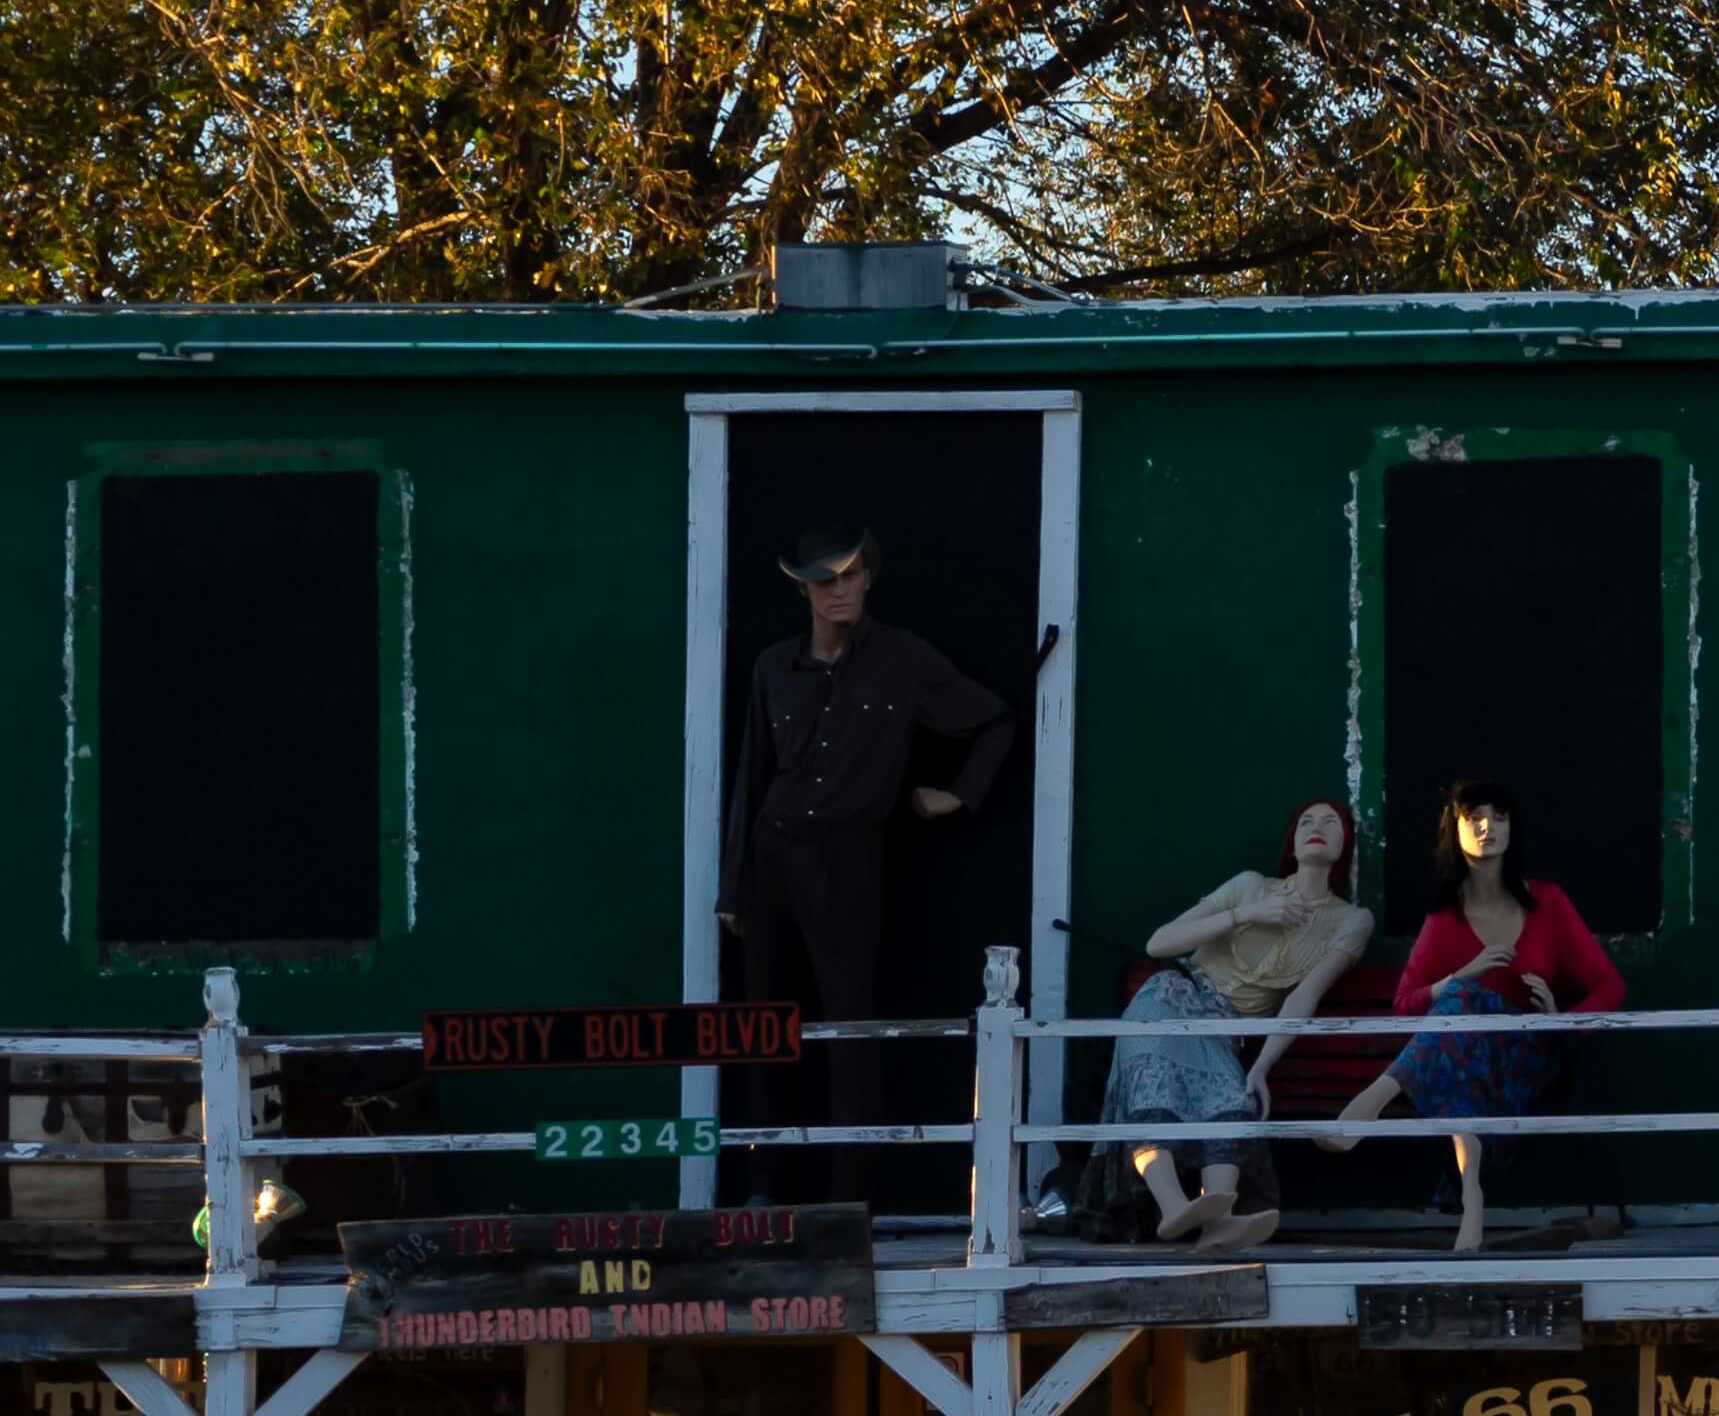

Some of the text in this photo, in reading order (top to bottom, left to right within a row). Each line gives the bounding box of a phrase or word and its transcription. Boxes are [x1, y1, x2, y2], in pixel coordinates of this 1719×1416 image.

[442, 1007, 781, 1063] RUSTY BOLT BLVD
[543, 1119, 717, 1158] 22345
[450, 1209, 796, 1255] THE RUSTY BOLT
[578, 1259, 652, 1295] AND
[376, 1296, 847, 1349] THUNDERBIRD INDIAN STORE
